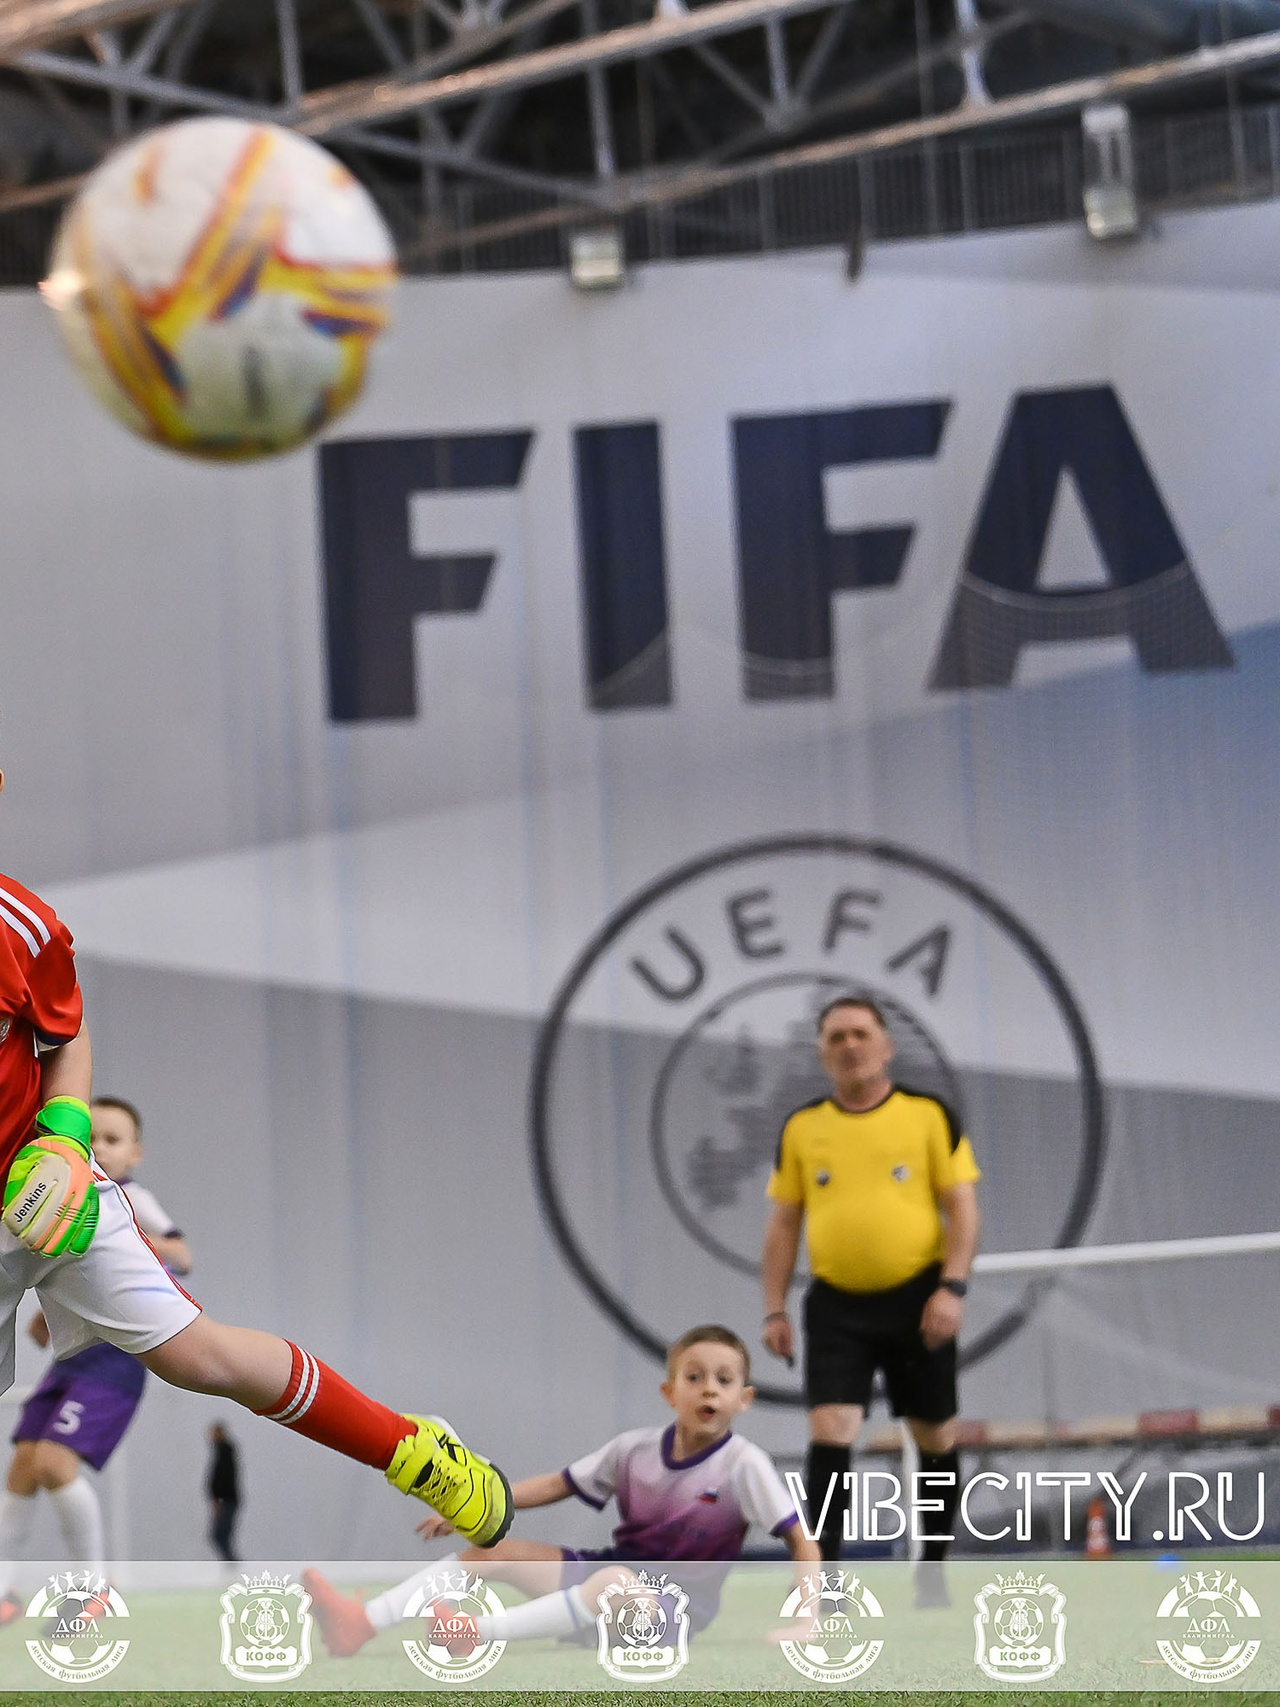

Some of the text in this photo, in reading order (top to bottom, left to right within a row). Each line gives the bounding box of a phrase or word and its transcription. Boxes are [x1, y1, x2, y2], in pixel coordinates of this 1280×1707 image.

[317, 381, 1235, 723] FIFA
[629, 888, 951, 1003] UEFA
[14, 1182, 47, 1223] Jenkins
[52, 1401, 85, 1435] 5
